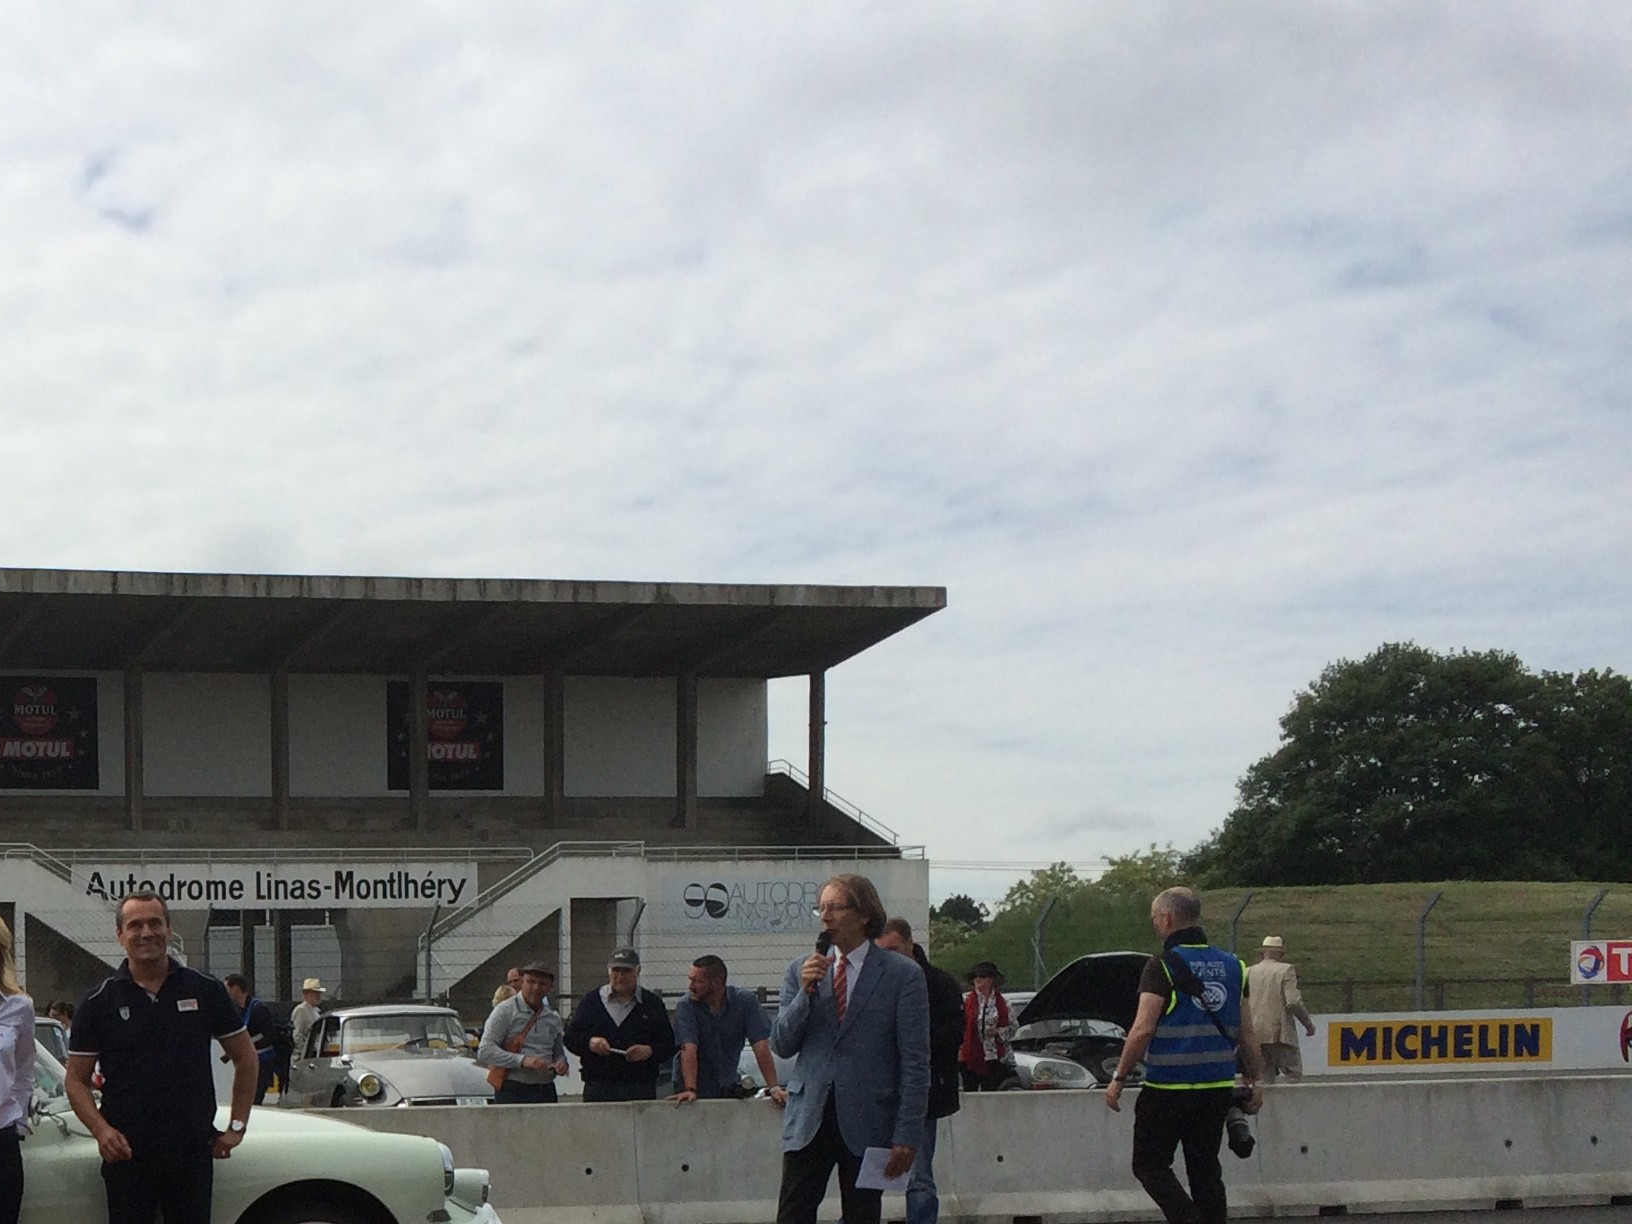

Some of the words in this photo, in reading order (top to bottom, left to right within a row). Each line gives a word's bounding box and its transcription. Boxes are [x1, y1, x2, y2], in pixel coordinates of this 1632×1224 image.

[13, 704, 58, 716] MOTUL
[2, 740, 71, 758] MOTUL
[428, 743, 477, 760] OTUL
[255, 869, 466, 905] Linas-Montlhéry
[730, 881, 819, 904] AUTODR
[1340, 1023, 1541, 1061] MICHELIN
